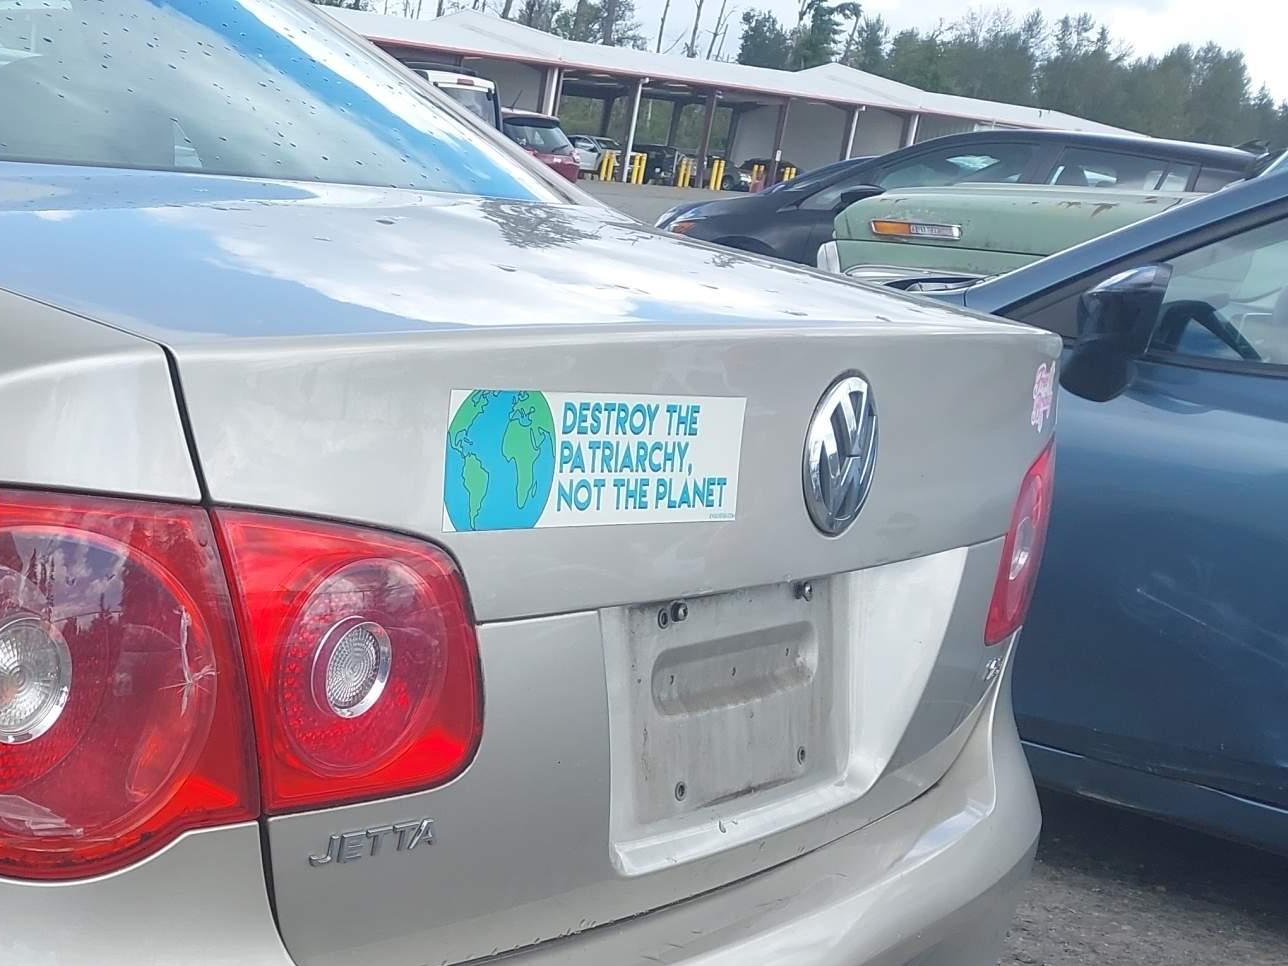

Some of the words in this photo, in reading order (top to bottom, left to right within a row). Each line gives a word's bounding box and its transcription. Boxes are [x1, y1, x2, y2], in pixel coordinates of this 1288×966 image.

[561, 401, 661, 436] DESTROY
[665, 404, 701, 437] THE
[558, 440, 693, 476] PATRIARCHY,
[556, 478, 607, 512] NOT
[612, 478, 650, 511] THE
[654, 476, 728, 510] PLANET
[308, 818, 435, 867] JETTA
